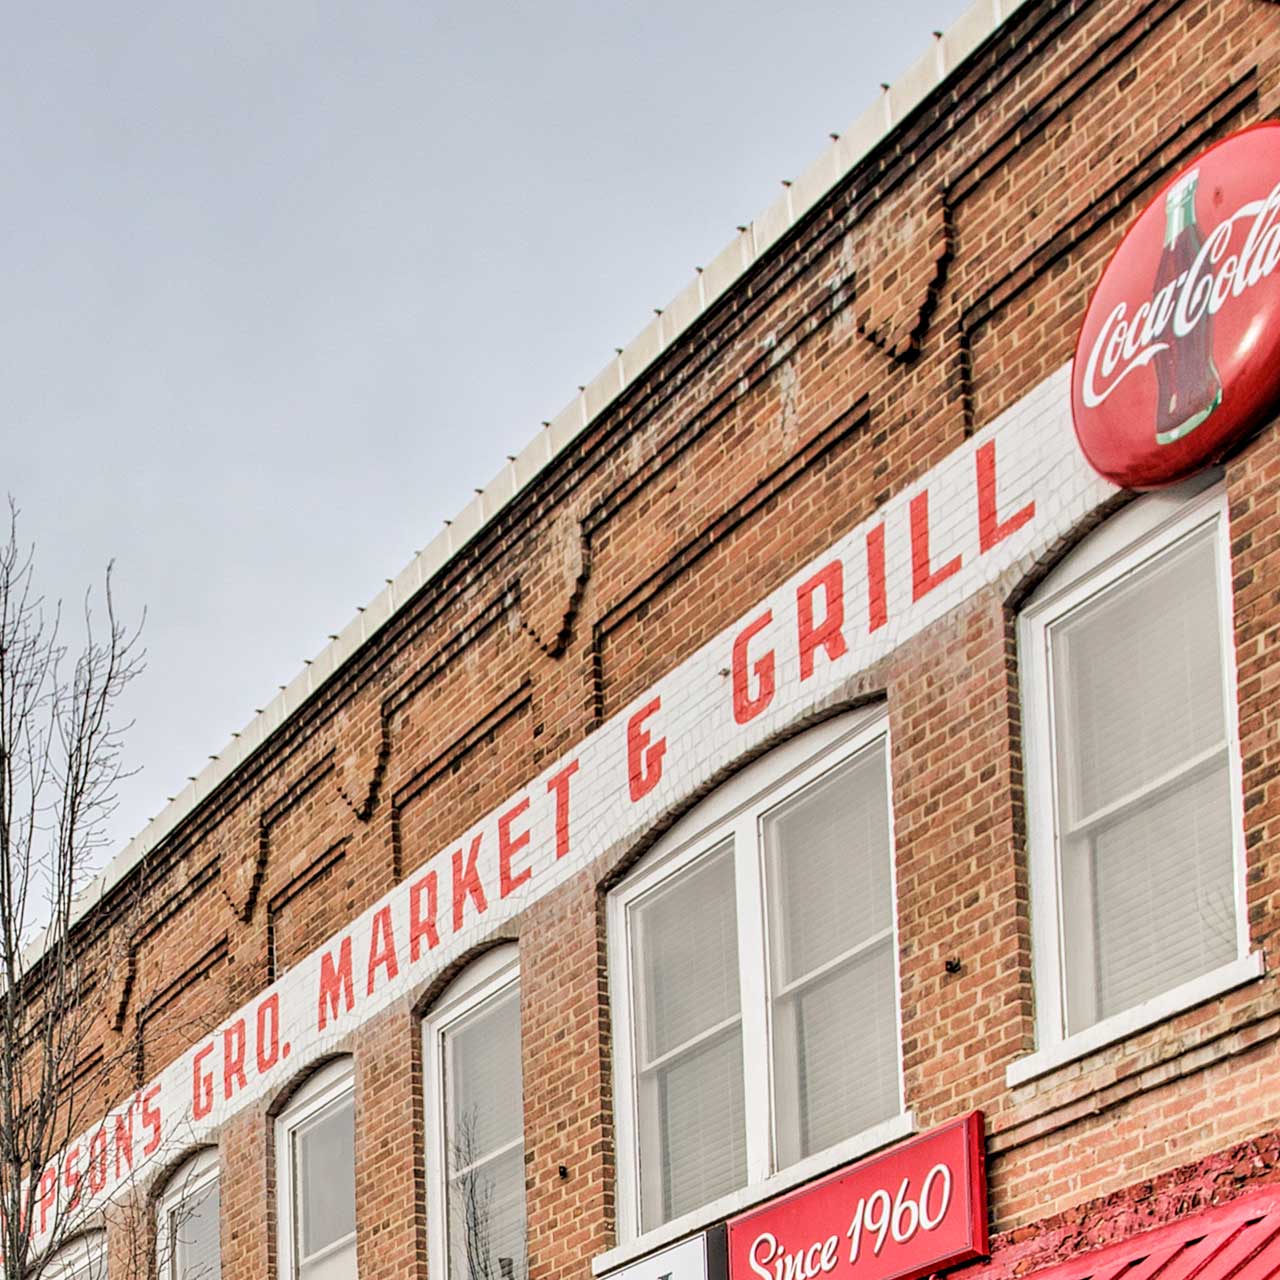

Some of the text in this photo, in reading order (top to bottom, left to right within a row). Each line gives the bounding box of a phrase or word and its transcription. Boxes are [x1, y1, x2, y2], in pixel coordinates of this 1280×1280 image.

[193, 993, 291, 1121] GRO.
[317, 758, 580, 1032] MARKET
[626, 695, 667, 802] &
[732, 438, 1036, 726] GRILL
[844, 1162, 952, 1264] 1960
